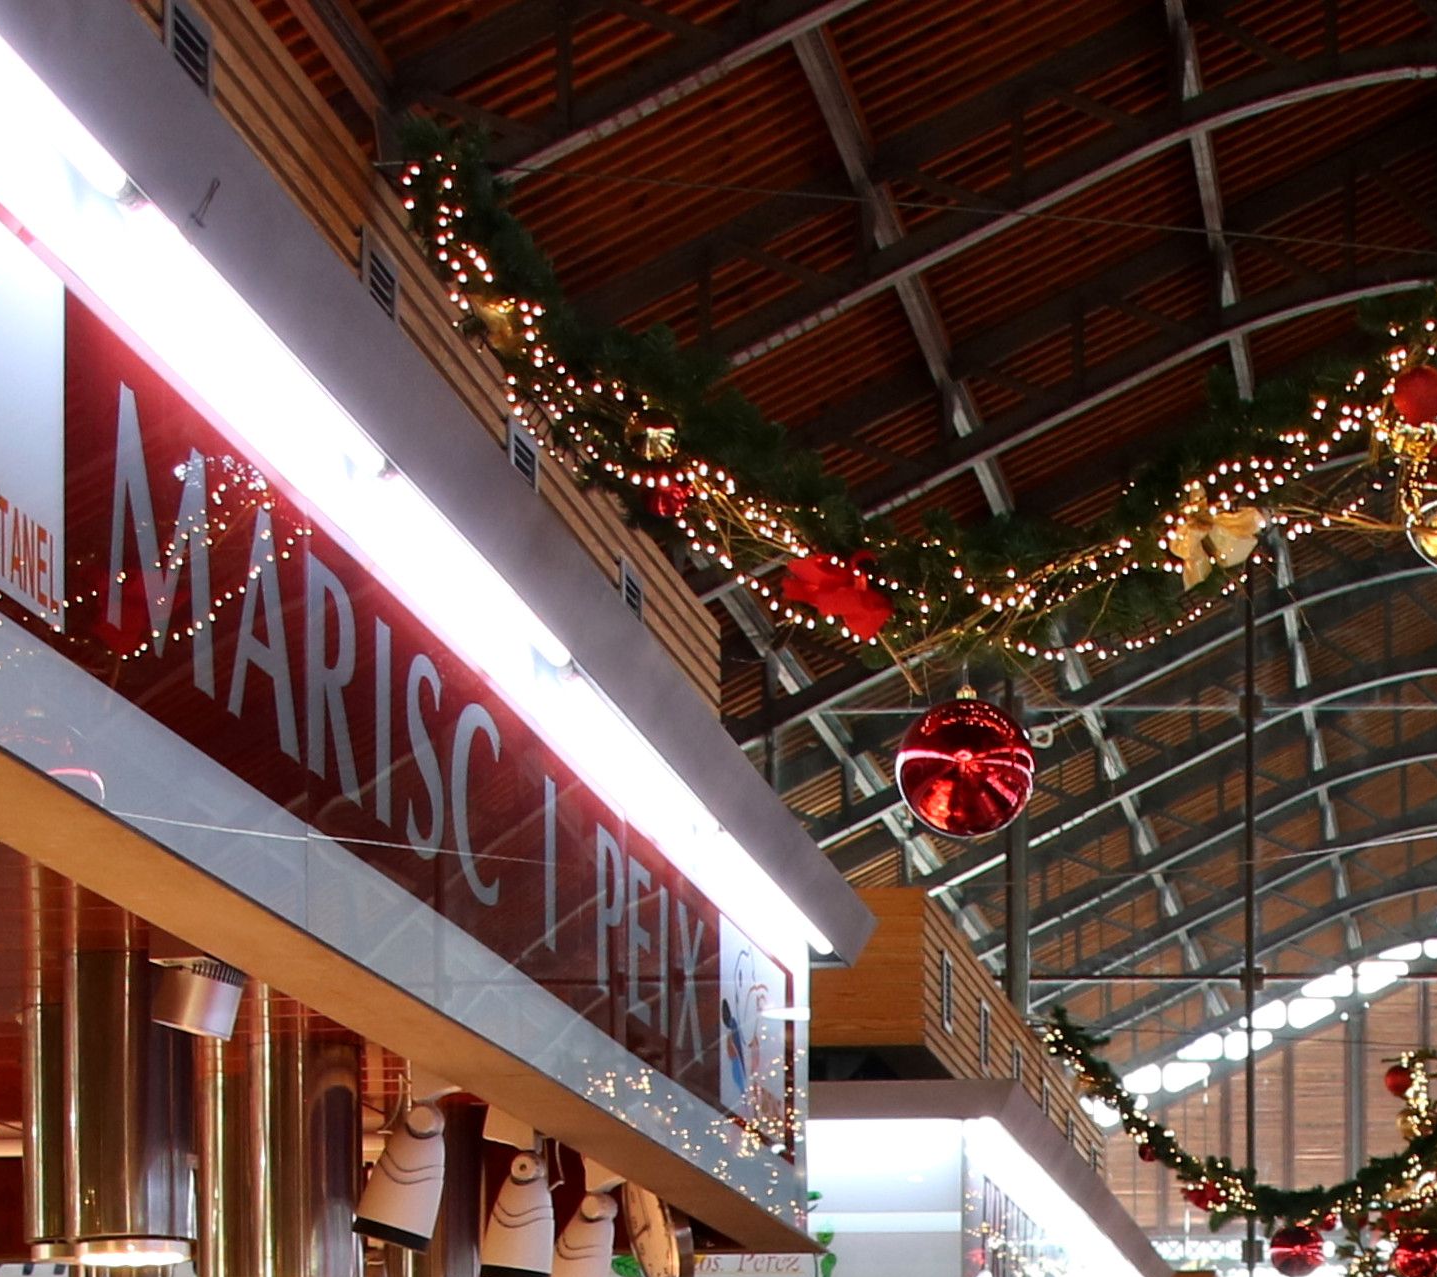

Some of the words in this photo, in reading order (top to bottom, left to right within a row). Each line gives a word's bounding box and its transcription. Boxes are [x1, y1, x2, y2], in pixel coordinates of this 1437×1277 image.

[106, 379, 501, 907] MARISC
[543, 774, 558, 953] I
[595, 821, 705, 1064] PEIX
